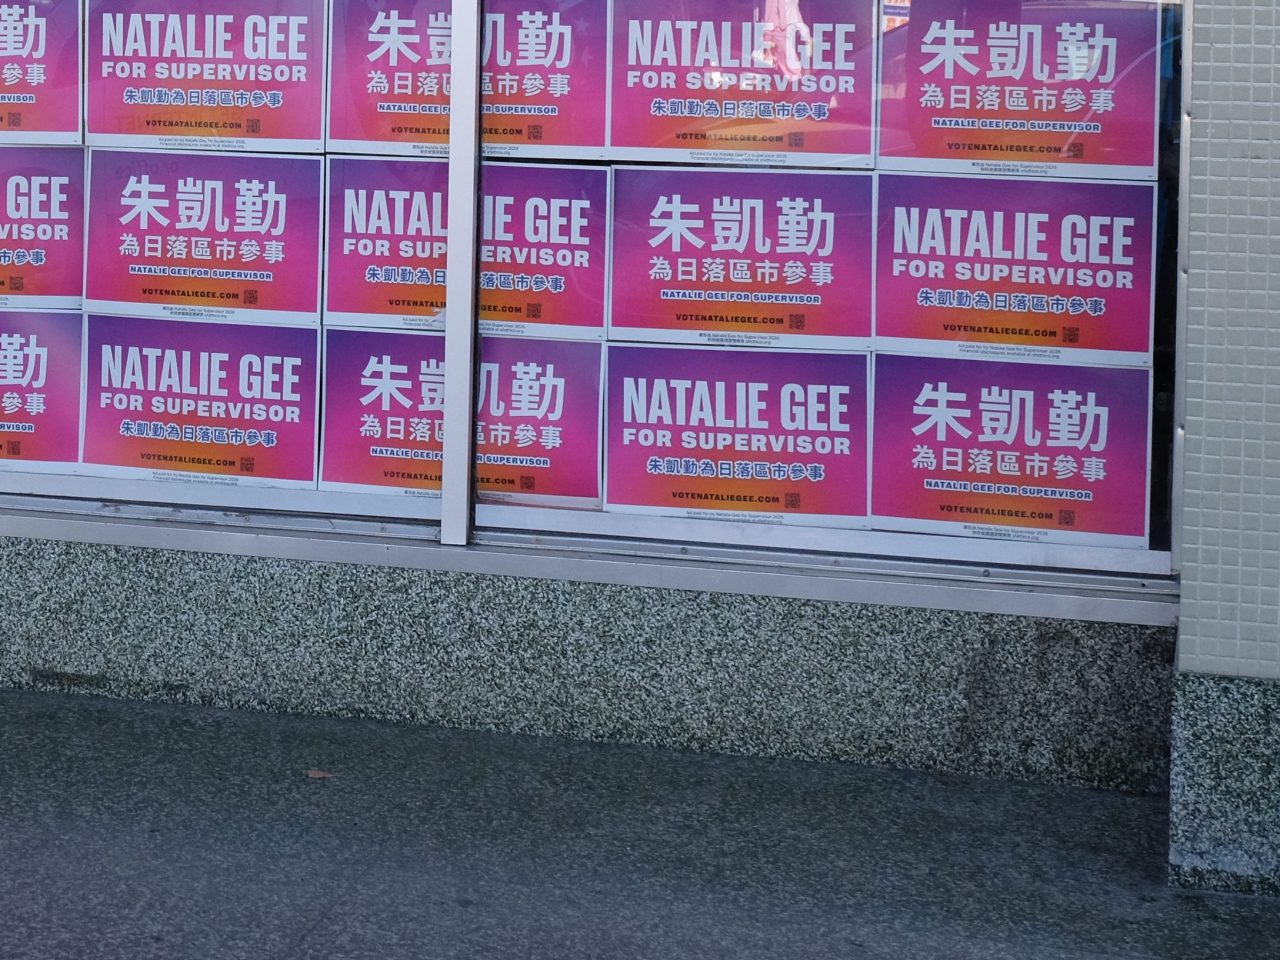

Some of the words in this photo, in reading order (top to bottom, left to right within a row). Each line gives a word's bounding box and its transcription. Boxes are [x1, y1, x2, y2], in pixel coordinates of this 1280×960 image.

[101, 13, 234, 59] NATALIE
[244, 16, 307, 60] GEE
[627, 20, 774, 69] NATALIE
[785, 23, 855, 70] GEE
[919, 19, 1118, 83] 朱凱勤
[102, 62, 146, 78] FOR
[155, 63, 306, 81] SUPERVISOR
[627, 71, 676, 88] FOR
[686, 72, 855, 92] SUPERVISOR
[919, 83, 1116, 114] 為日落區市參事
[146, 119, 242, 129] VOTENATALIEGEE.COM
[932, 118, 977, 128] NATALIE
[980, 120, 1002, 129] GEE
[1004, 121, 1026, 130] FOR
[1029, 121, 1101, 132] SUPERVISOR
[947, 143, 1062, 153] VOTENATALIEGEE.COM
[6, 175, 69, 219] GEE
[118, 174, 287, 235] 朱凱勤
[524, 198, 590, 245] GEE
[648, 194, 835, 256] 朱凱勤
[893, 206, 1049, 261] NATALIE
[1060, 215, 1134, 265] GEE
[118, 233, 286, 264] 為日落區市參事
[343, 239, 390, 256] FOR
[648, 256, 835, 286] 為日落區市參事
[893, 259, 945, 278] FOR
[955, 262, 1134, 288] SUPERVISOR
[142, 288, 239, 299] VOTENATALIEGEE.COM
[661, 290, 704, 300] NATALIE
[706, 292, 727, 301] GEE
[729, 292, 750, 302] FOR
[752, 293, 821, 304] SUPERVISOR
[676, 314, 784, 324] VOTENATALIEGEE.COM
[943, 324, 1057, 337] VOTENATALIEGEE.COM
[100, 345, 230, 397] NATALIE
[239, 354, 302, 401] GEE
[100, 393, 143, 411] FOR
[151, 397, 300, 423] SUPERVISOR
[622, 378, 769, 429] NATALIE
[779, 384, 850, 431] GEE
[911, 381, 1109, 452] 朱凱勤
[623, 429, 671, 447] FOR
[681, 431, 850, 454] SUPERVISOR
[911, 444, 1108, 482] 為日落區市參事
[672, 491, 779, 503] VOTENATALIEGEE.COM
[925, 479, 969, 491] NATALIE
[972, 483, 994, 493] GEE
[996, 485, 1018, 495] FOR
[1020, 487, 1092, 500] SUPERVISOR
[940, 505, 1053, 520] VOTENATALIEGEE.COM
